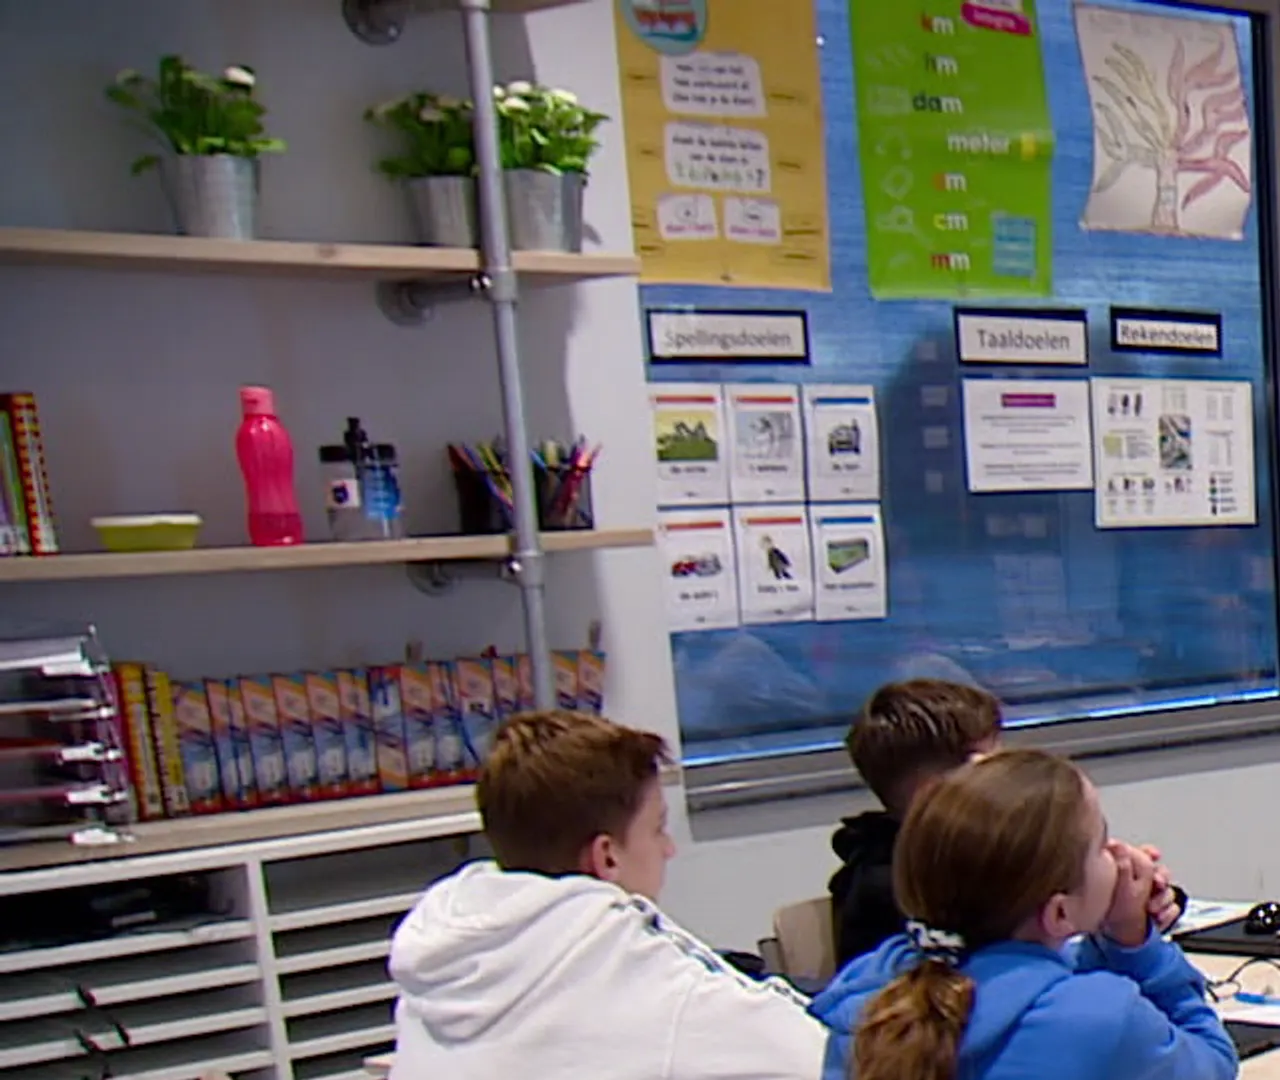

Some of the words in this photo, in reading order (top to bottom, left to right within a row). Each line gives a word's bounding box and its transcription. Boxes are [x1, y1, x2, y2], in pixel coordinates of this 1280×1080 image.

[912, 91, 963, 114] dam
[947, 133, 1010, 155] meter
[933, 212, 968, 231] cm
[931, 253, 970, 272] mm
[665, 328, 791, 351] Spellingsdoelen
[977, 328, 1070, 351] Taaldoelen
[1120, 324, 1215, 343] Rekendoelen
